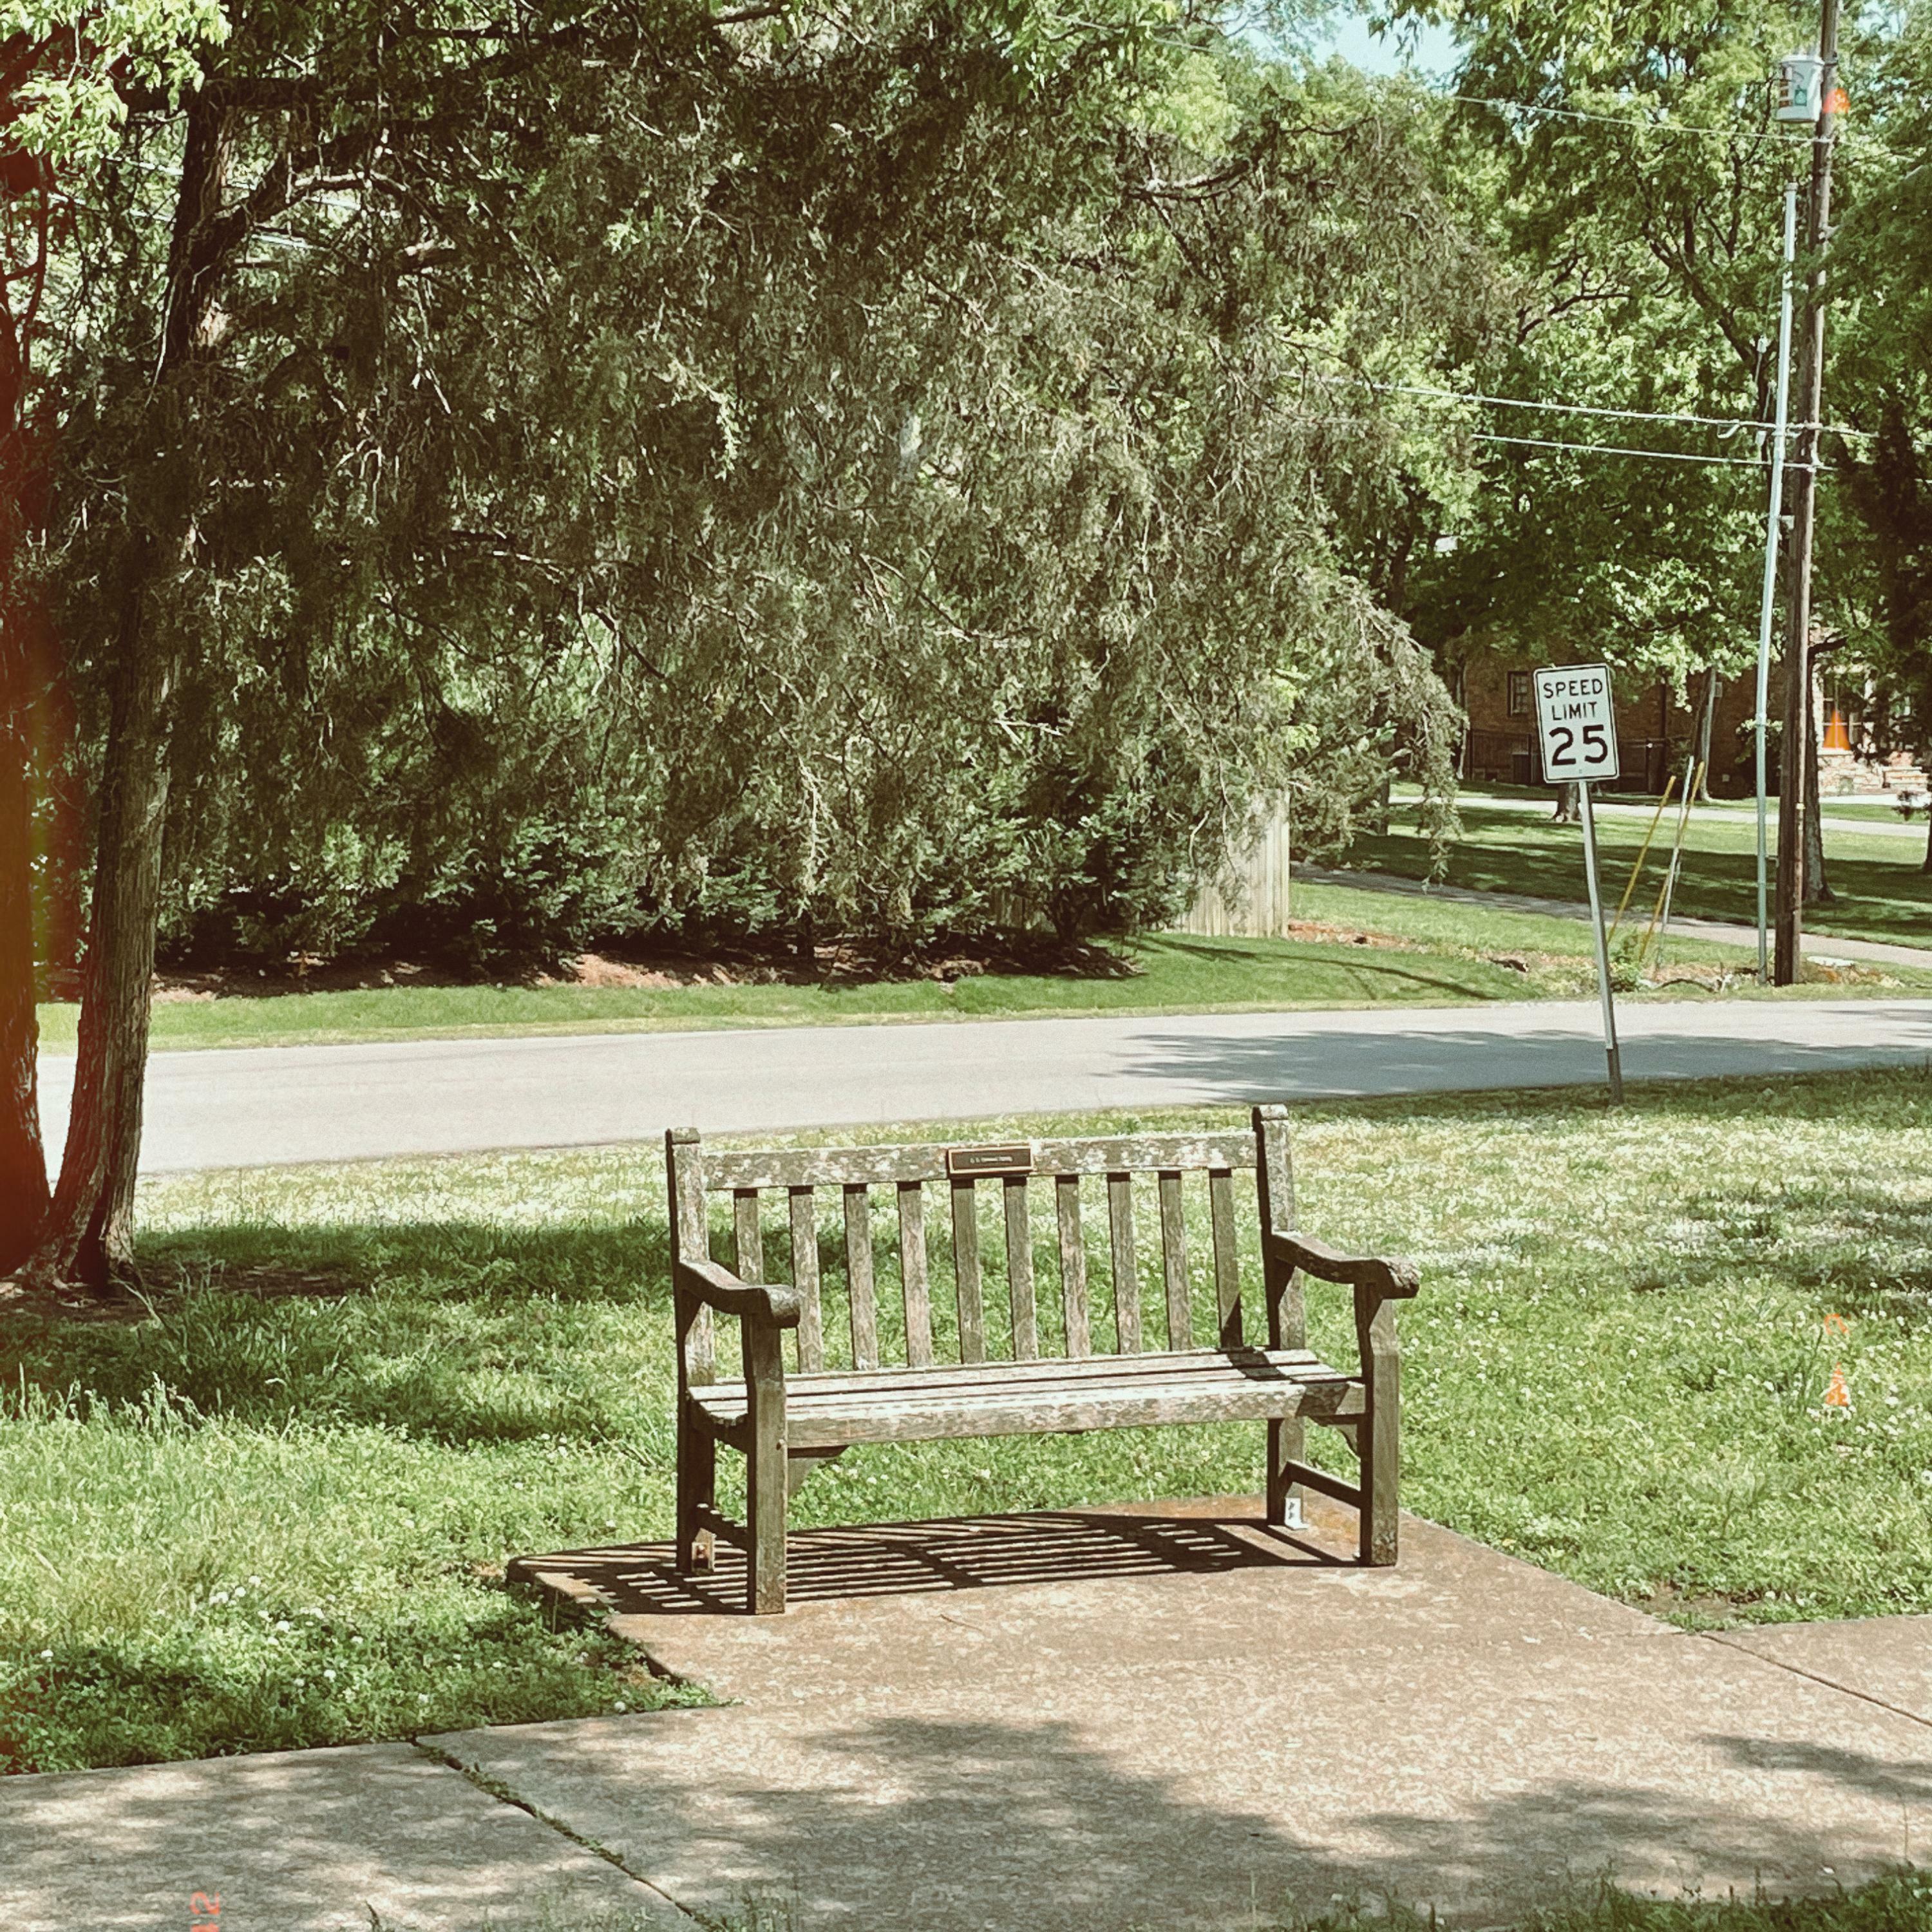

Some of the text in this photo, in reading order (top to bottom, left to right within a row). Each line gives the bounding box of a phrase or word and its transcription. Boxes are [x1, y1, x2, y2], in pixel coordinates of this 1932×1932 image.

[1543, 678, 1603, 699] SPEED
[1551, 701, 1598, 721] LIMIT
[1549, 724, 1608, 766] 25
